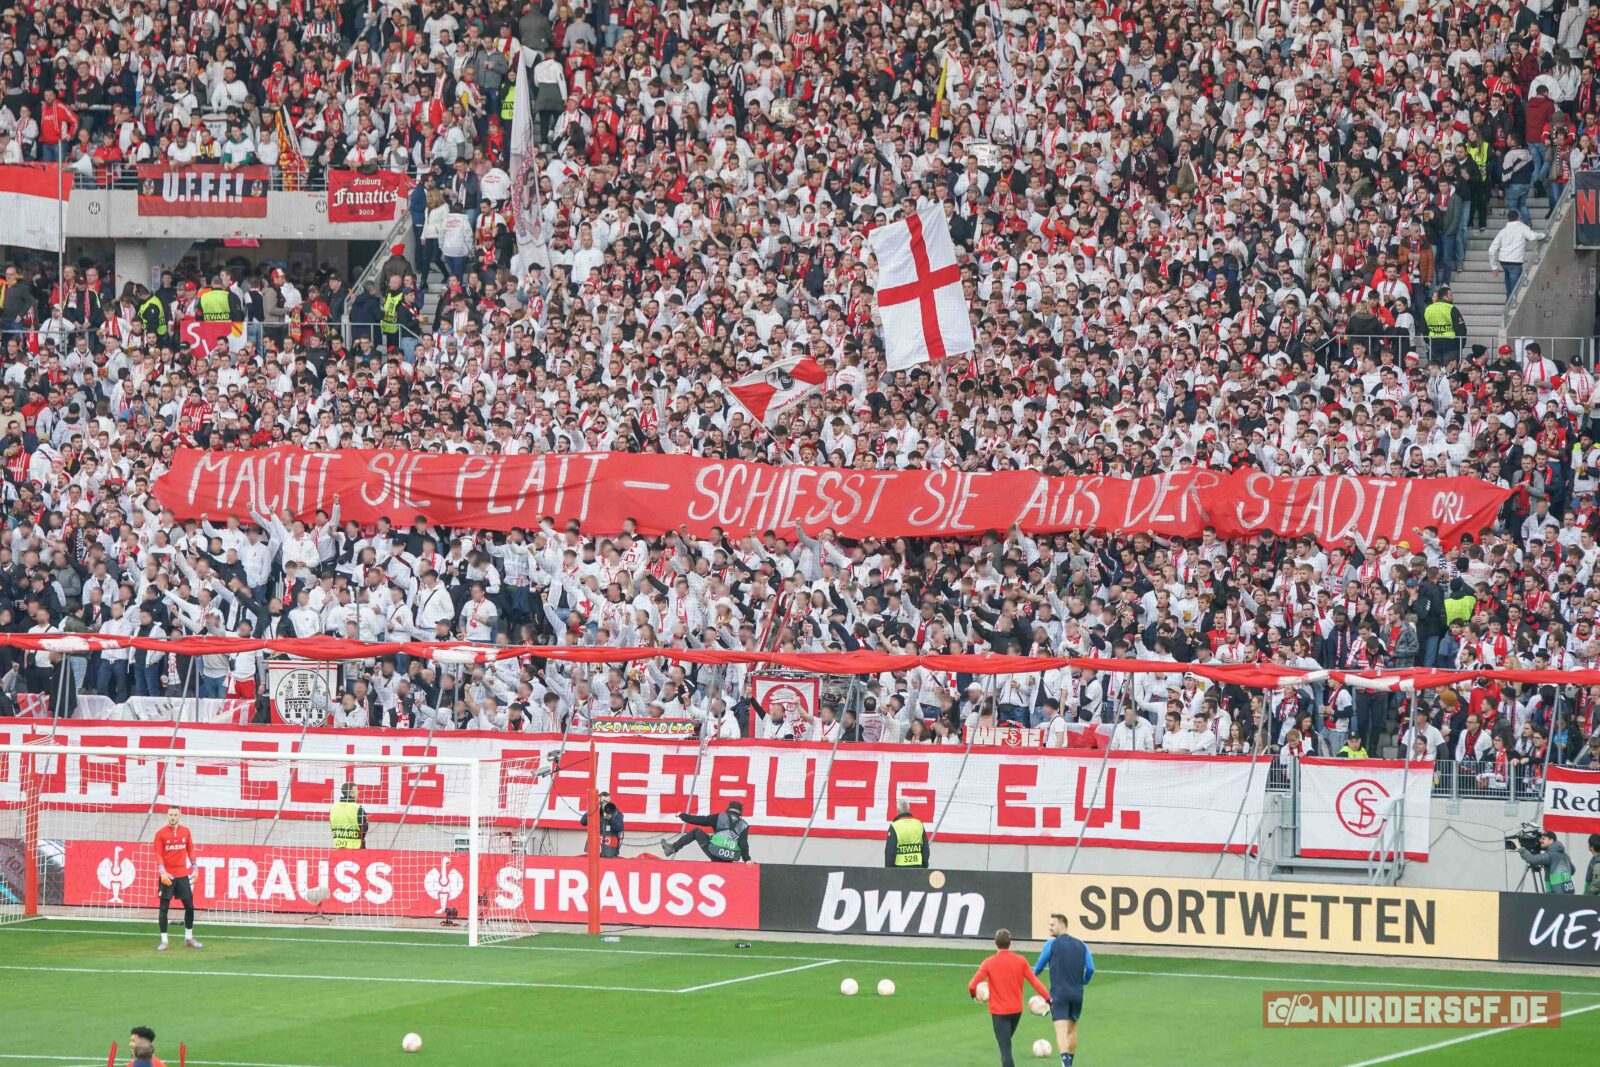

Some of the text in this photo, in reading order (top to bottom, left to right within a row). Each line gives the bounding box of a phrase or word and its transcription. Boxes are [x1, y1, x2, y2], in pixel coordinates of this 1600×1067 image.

[332, 187, 399, 206] Fanatics
[1577, 189, 1600, 224] N
[187, 452, 342, 514] MACHT
[361, 452, 438, 509] SIE
[456, 453, 609, 521] PLATT
[688, 464, 898, 532] SCHIESST
[908, 471, 992, 531] SIE
[1020, 476, 1104, 526] AUS
[1123, 471, 1218, 528] DER
[0, 733, 444, 808] ORT-CLUB
[498, 748, 935, 822] FREIBURG
[718, 848, 735, 859] 003
[903, 854, 919, 863] 328
[186, 855, 393, 904] TRAUSS
[496, 866, 727, 918] STRAUSS
[816, 870, 985, 936] bwin
[1079, 885, 1436, 946] SPORTWETTEN
